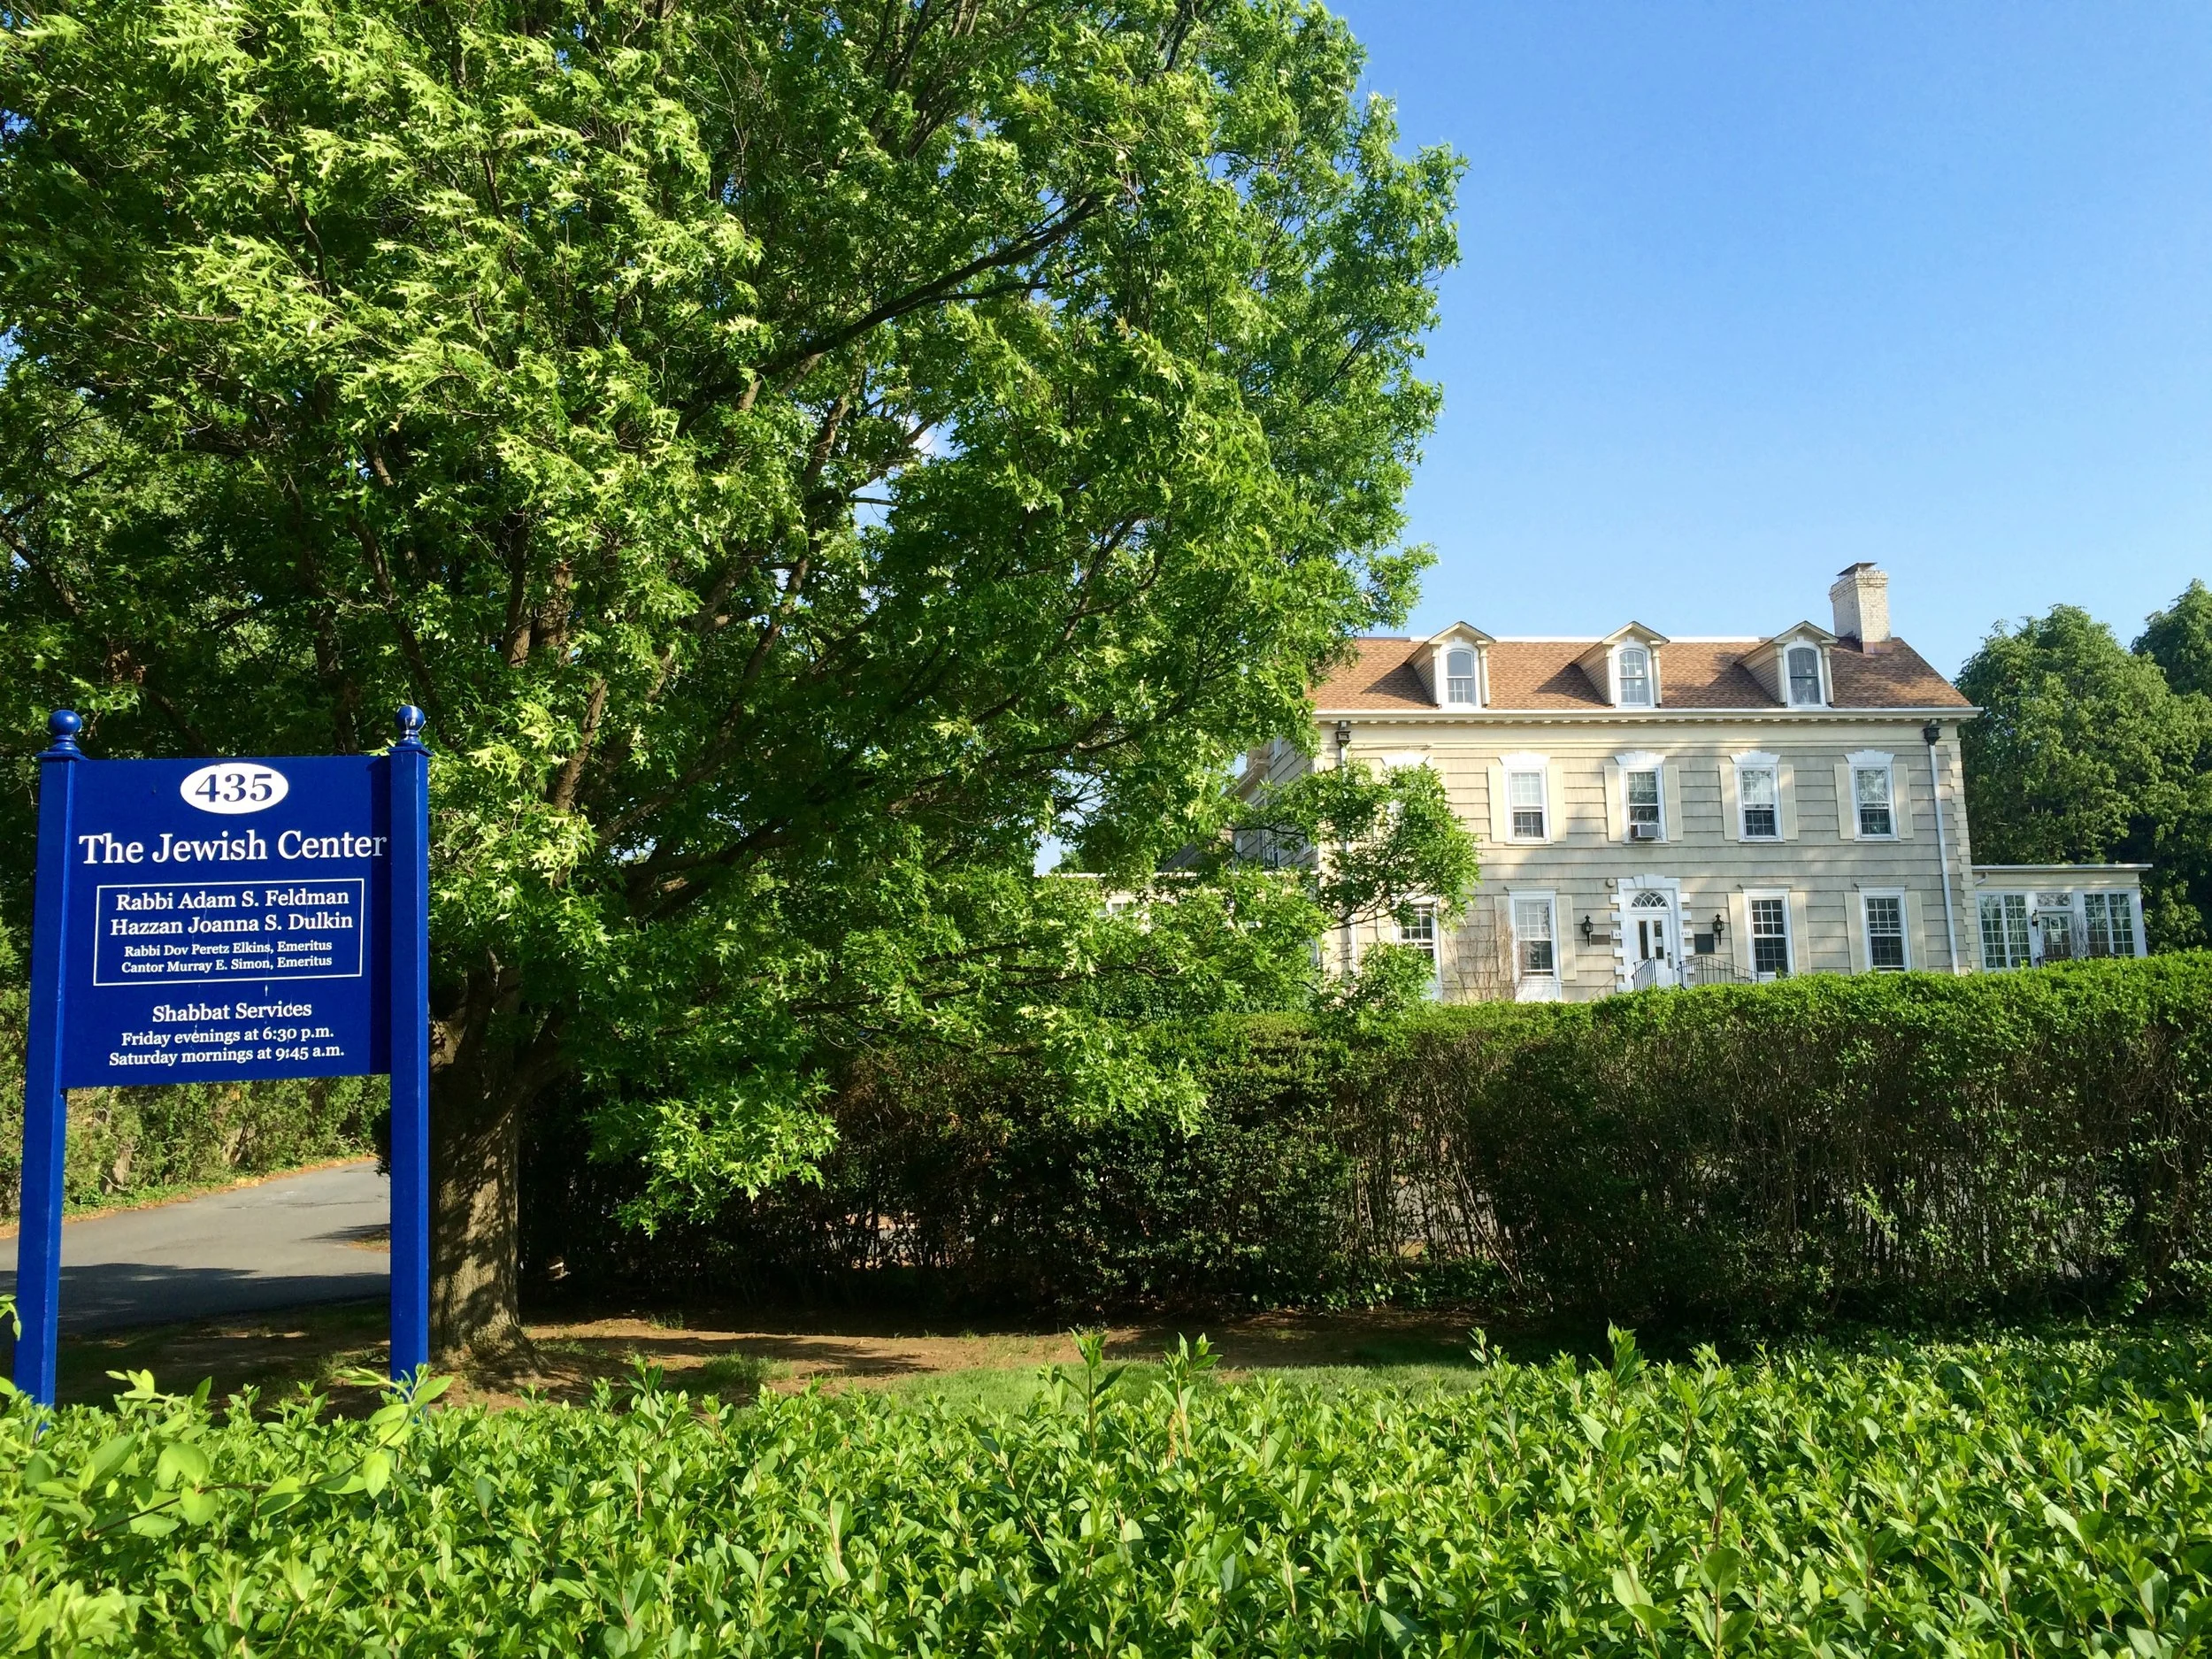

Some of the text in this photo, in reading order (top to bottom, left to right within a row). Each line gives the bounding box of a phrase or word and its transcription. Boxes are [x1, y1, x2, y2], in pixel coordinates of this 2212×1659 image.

[196, 773, 273, 803] 435
[79, 829, 387, 864] The Jewish Center
[116, 888, 349, 910] Rabbi Adam S. Feldman
[111, 912, 353, 935] Hazzan Joanna S. Dulkin
[125, 940, 332, 956] Rabbi Dov Peretz Elkins, Emeritus
[122, 956, 332, 974] Cantor Murray E. Simon, Emeritus
[153, 1002, 311, 1022] Shabbat Services
[121, 1026, 334, 1048] Friday evenings at 6:30 p.m.
[110, 1047, 344, 1066] Saturday mornings at 9:45 a.m.
